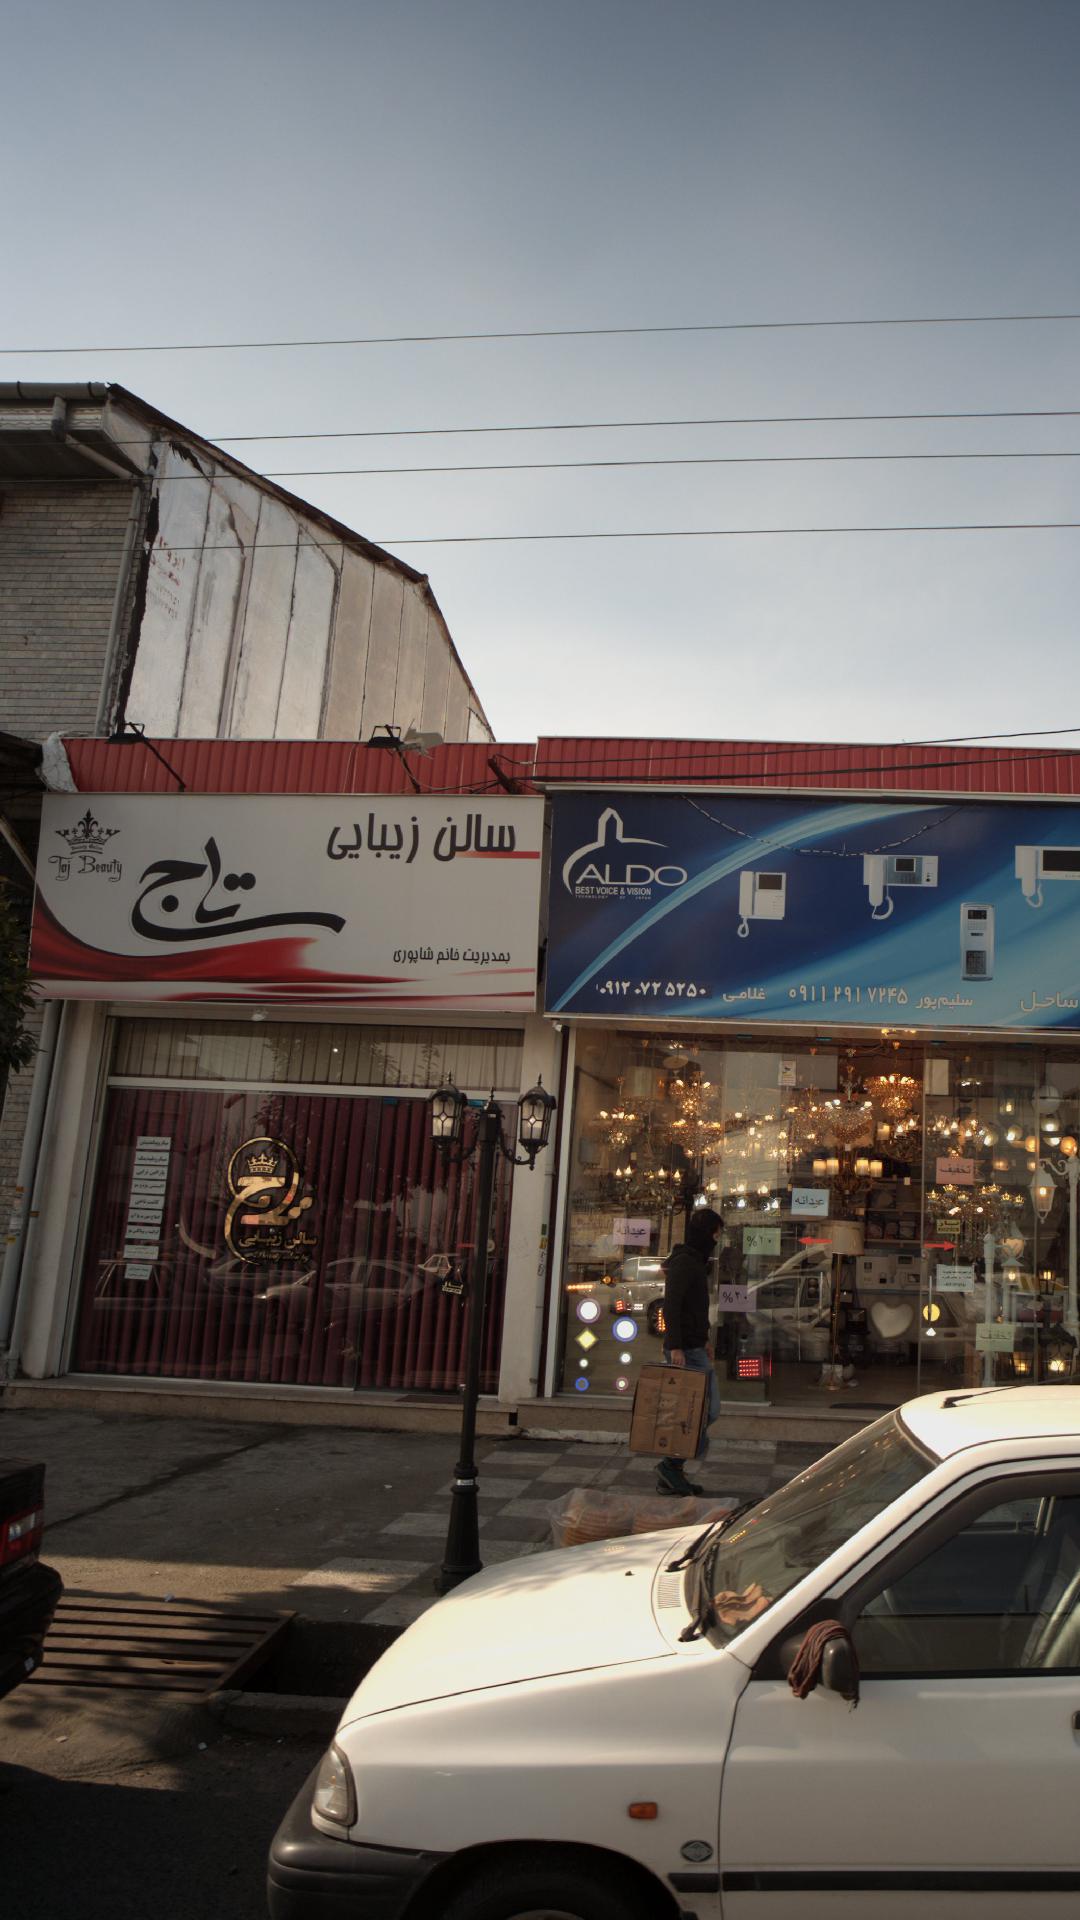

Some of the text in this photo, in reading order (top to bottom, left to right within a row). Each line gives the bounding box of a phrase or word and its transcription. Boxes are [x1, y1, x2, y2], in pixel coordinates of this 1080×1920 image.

[327, 813, 516, 863] سالن زیبایی
[48, 855, 122, 882] Taj Beauty
[575, 863, 688, 887] ALDO
[131, 836, 346, 942] تاج
[575, 886, 652, 896] BEST VOICE & VISION
[393, 947, 511, 965] بمدیریت خانم شاپوری
[722, 987, 766, 1002] غلامی
[285, 1231, 318, 1249] سالن
